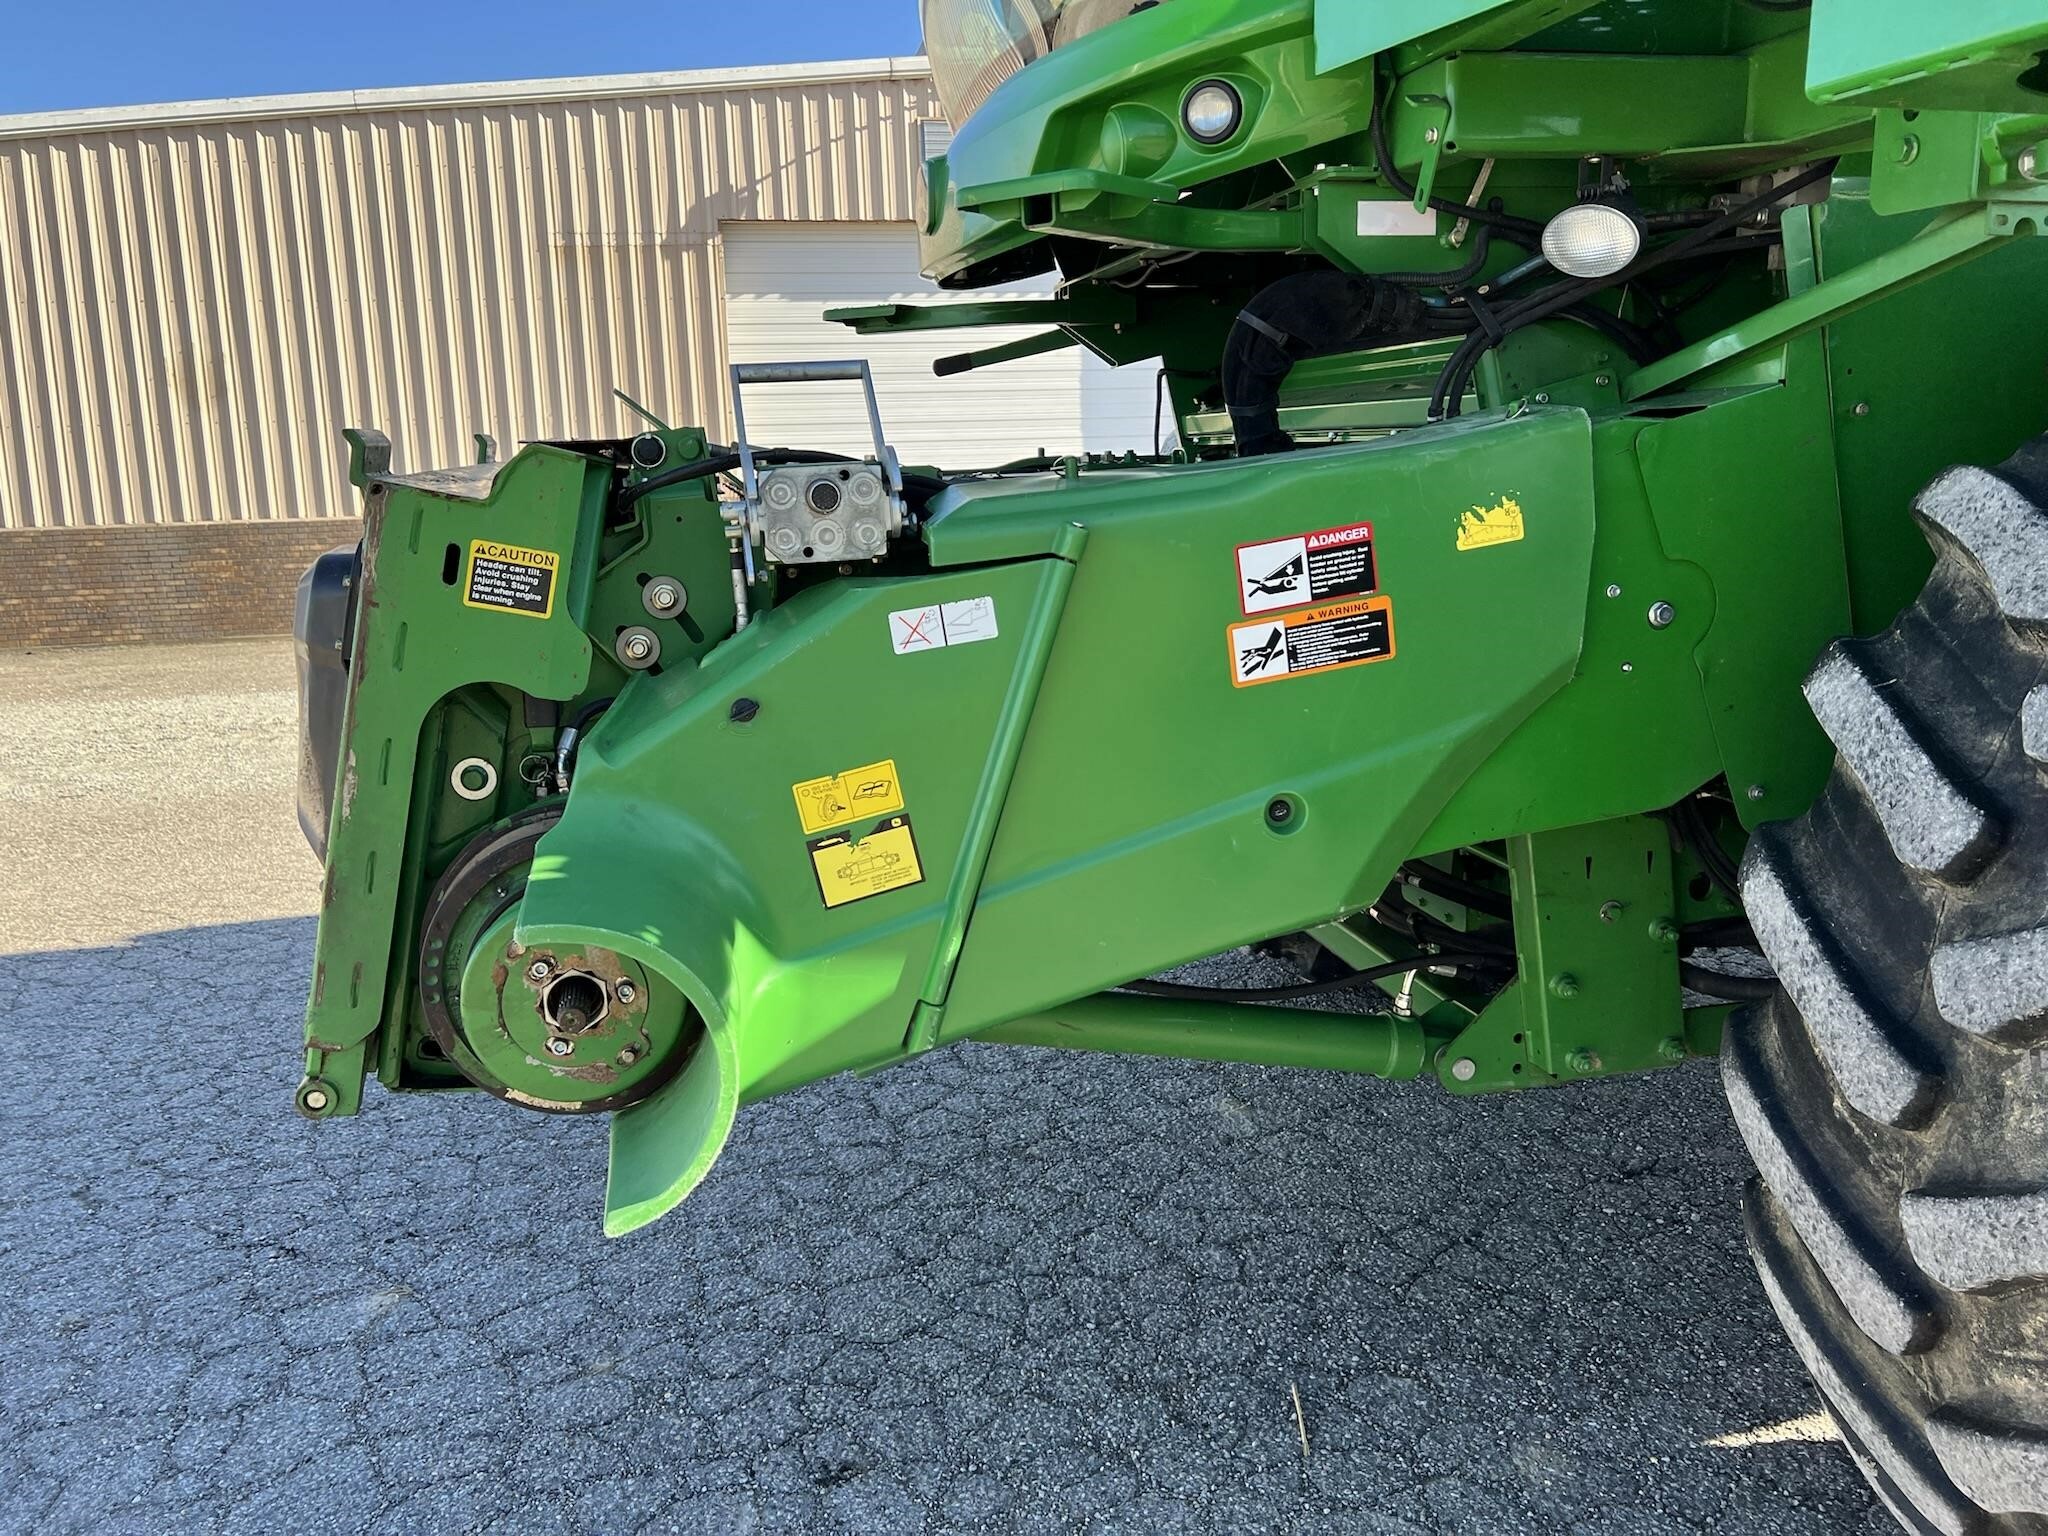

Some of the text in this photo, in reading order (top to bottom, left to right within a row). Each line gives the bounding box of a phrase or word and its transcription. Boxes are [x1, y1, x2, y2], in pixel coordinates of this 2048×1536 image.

[1318, 527, 1369, 545] DANGER
[488, 545, 554, 567] CAUTION
[475, 567, 539, 586] Avoid crushing
[476, 559, 542, 577] Header can tilt.
[472, 584, 542, 602] clear when engine
[511, 581, 531, 592] Stay
[471, 591, 515, 606] is running.
[1318, 602, 1369, 618] WARNING
